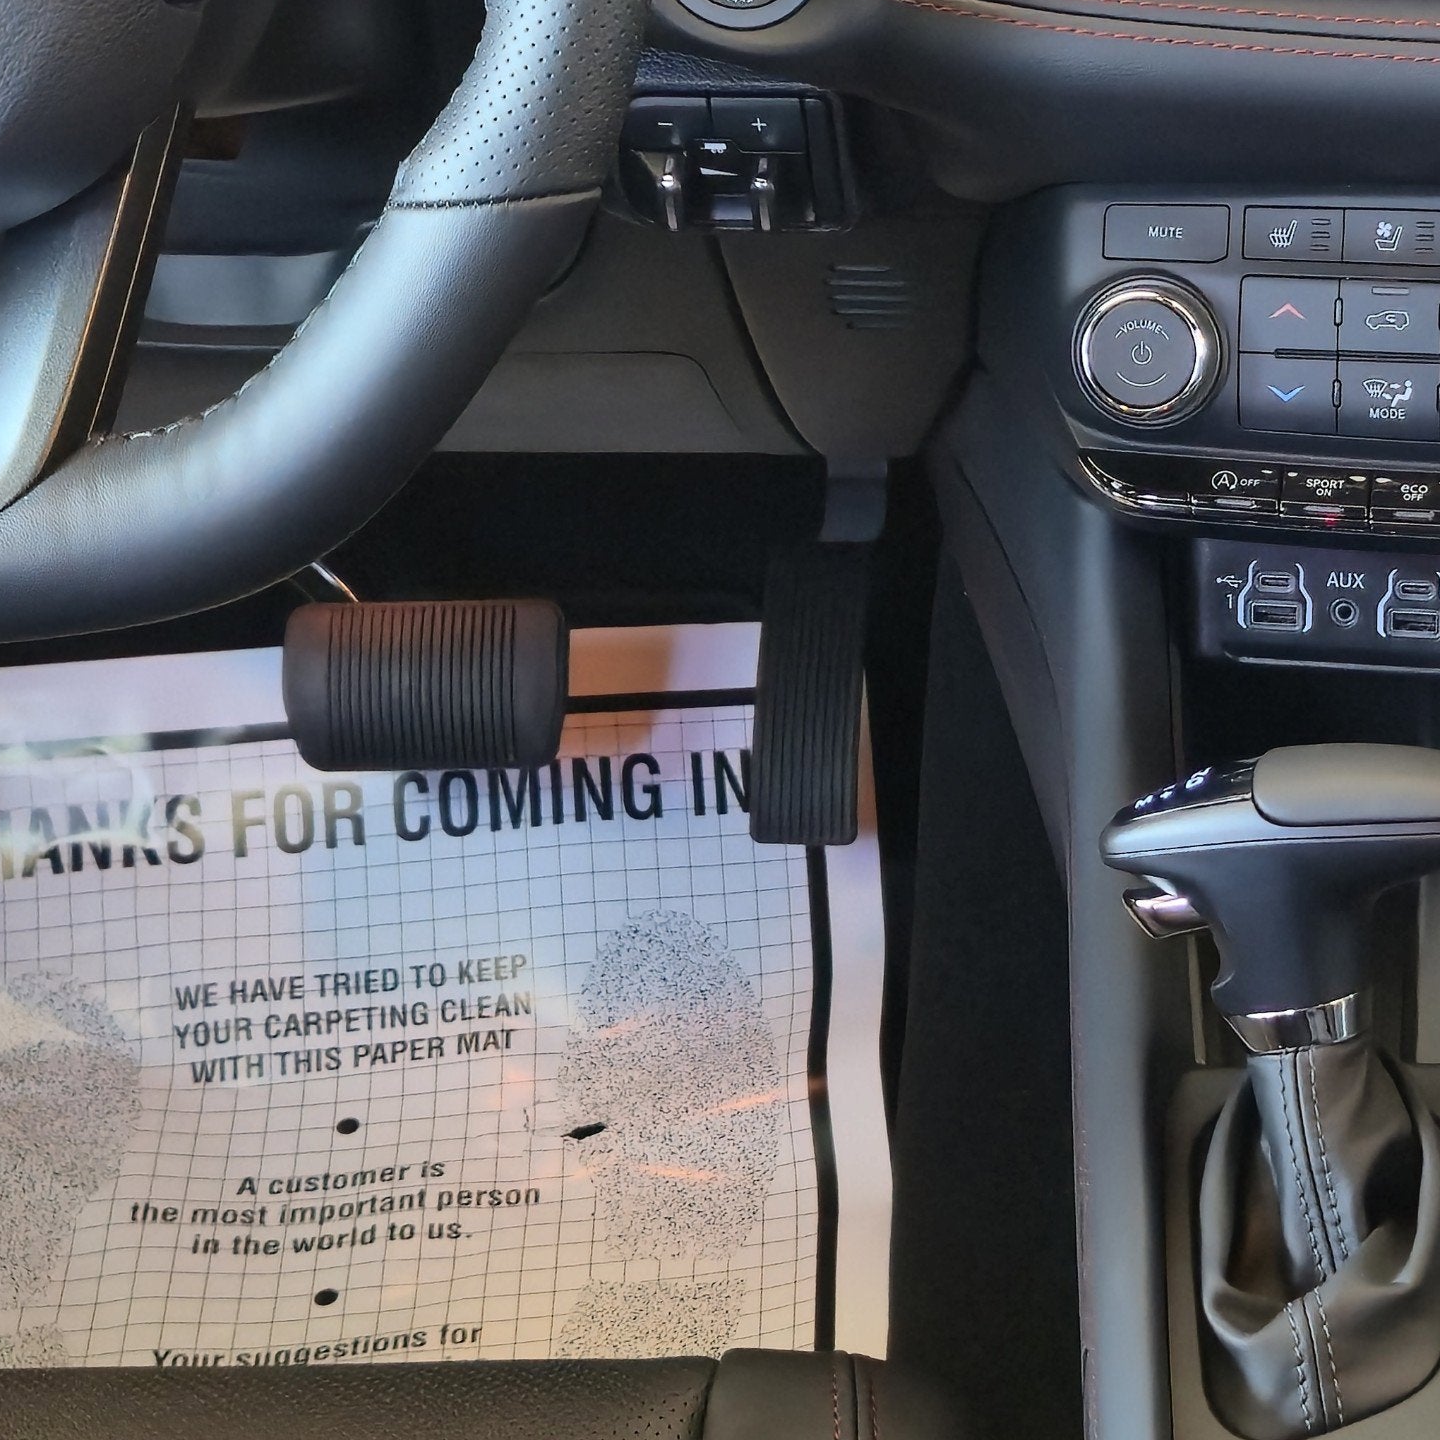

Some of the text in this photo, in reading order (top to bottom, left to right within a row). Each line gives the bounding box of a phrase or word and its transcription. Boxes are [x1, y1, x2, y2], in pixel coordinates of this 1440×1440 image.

[1148, 225, 1184, 239] MUTE
[1120, 320, 1163, 336] VOLUME
[1369, 406, 1407, 421] MODE
[1240, 478, 1260, 487] OFF
[1306, 478, 1345, 490] SPORT
[1400, 483, 1429, 494] eco
[1316, 487, 1332, 497] ON
[1403, 492, 1424, 501] OFF
[1326, 571, 1365, 589] AUX
[1226, 593, 1234, 609] 1
[231, 779, 366, 859] FOR
[392, 751, 666, 844] COMING
[692, 747, 752, 817] IN
[175, 953, 528, 1011] WE HAVE TRIED TO KEEP
[173, 990, 533, 1050] YOUR CARPETING CLEAN
[191, 1027, 517, 1084] WITH THIS PAPER MAT
[236, 1159, 446, 1196] A customer is
[130, 1185, 542, 1226] the most important person
[191, 1219, 473, 1257] in the world to us.
[235, 1328, 427, 1368] suggestions
[440, 1324, 484, 1346] for
